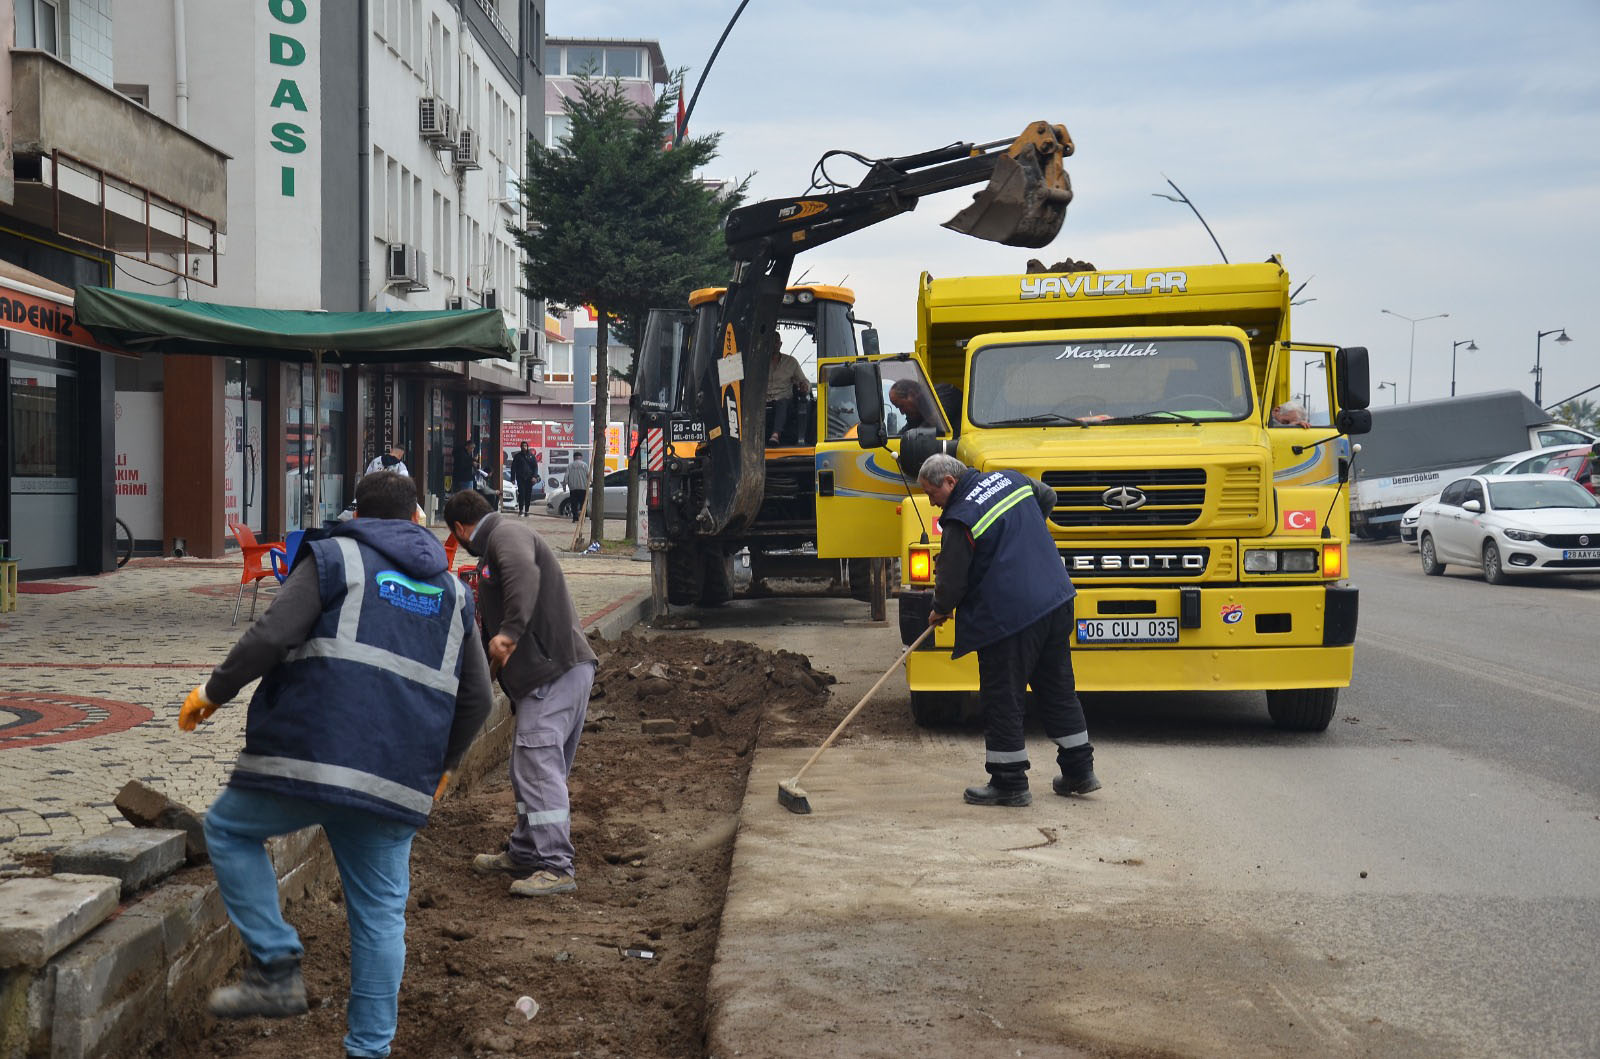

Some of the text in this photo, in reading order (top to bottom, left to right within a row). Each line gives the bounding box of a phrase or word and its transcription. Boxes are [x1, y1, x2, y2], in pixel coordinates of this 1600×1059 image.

[268, 0, 309, 198] ODASI
[1020, 271, 1188, 301] YAVUZLAR
[1055, 343, 1159, 361] Maşallah
[384, 386, 393, 456] OTURAKLA
[673, 423, 684, 432] 28
[691, 422, 702, 432] 02
[1061, 554, 1204, 571] ESOTO
[1086, 621, 1176, 638] 06 CUJ 035
